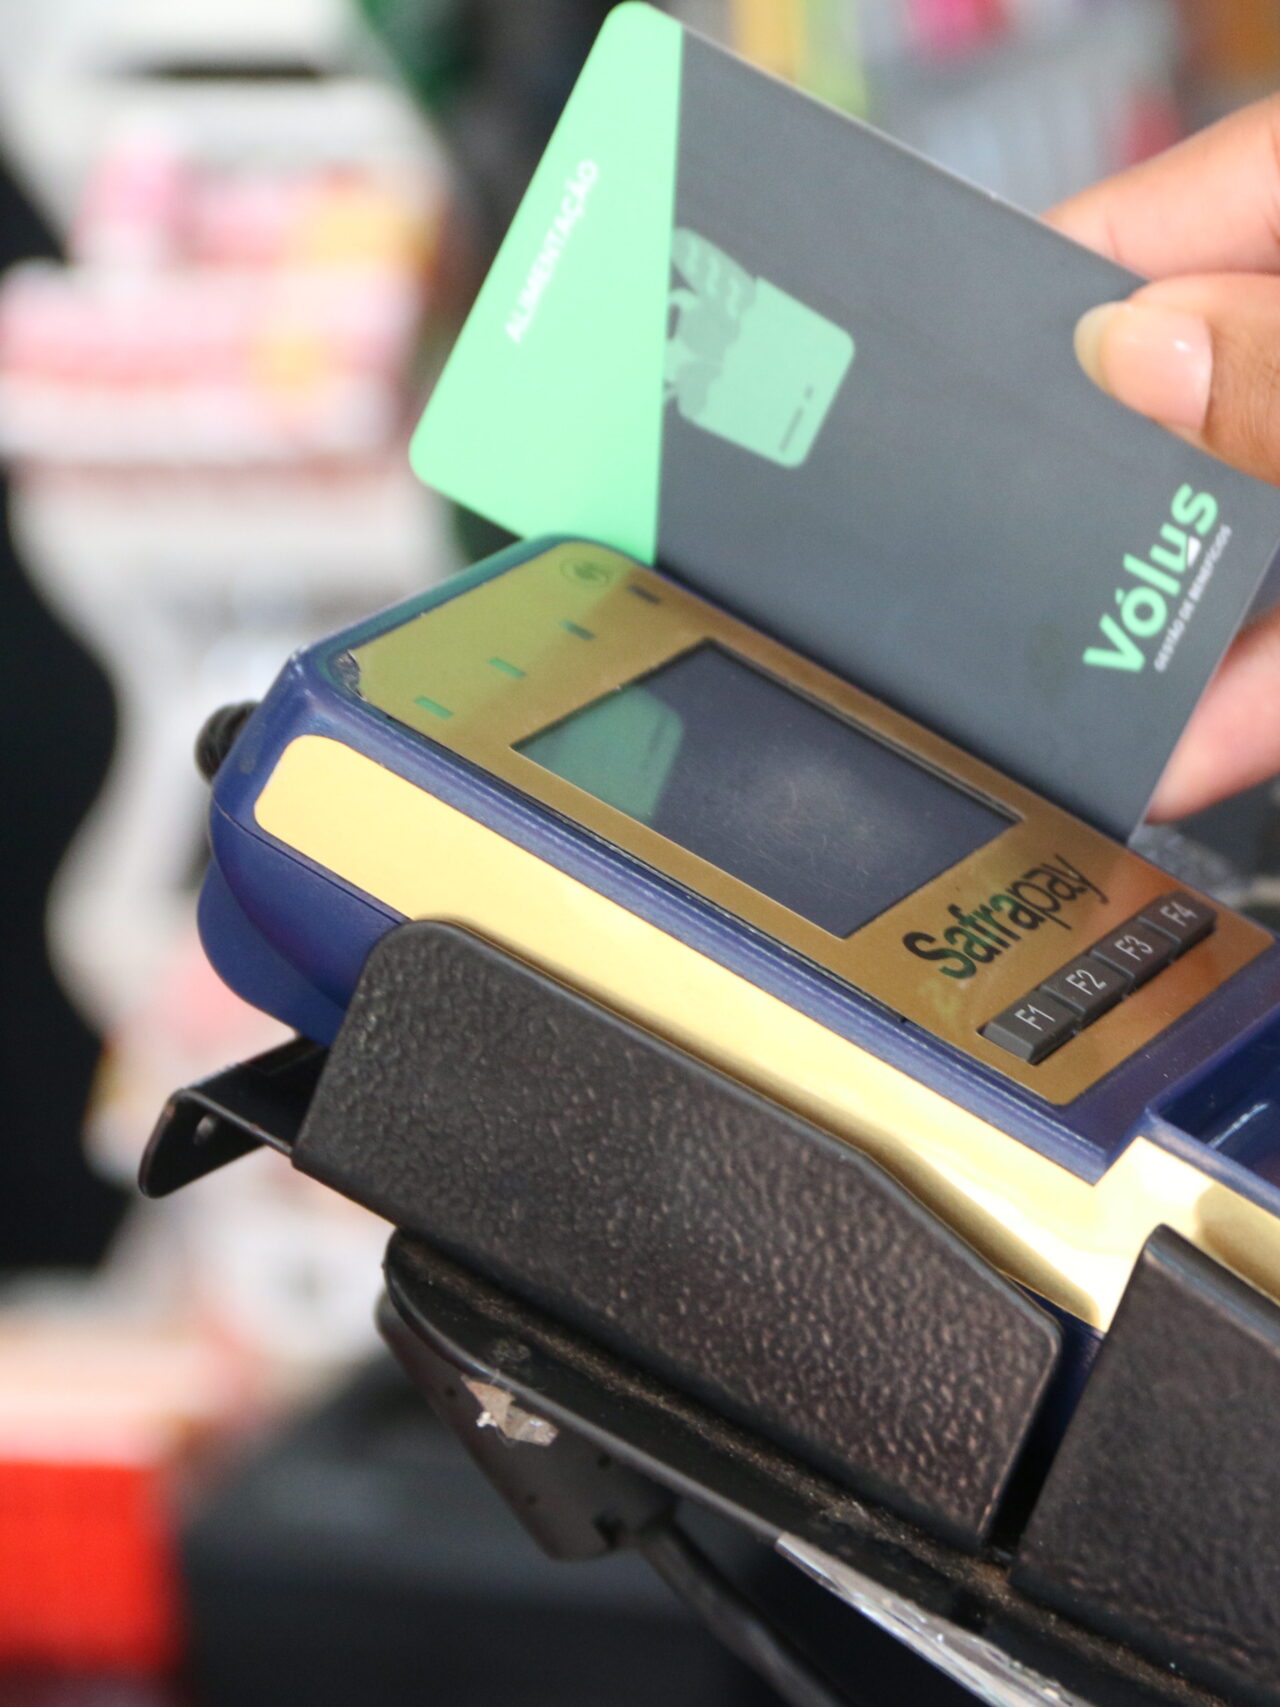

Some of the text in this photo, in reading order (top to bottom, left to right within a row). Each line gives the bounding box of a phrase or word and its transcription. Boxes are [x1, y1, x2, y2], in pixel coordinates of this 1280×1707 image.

[504, 159, 599, 344] ALIMENTAÇÃO
[1082, 483, 1218, 672] Vólus
[902, 854, 1109, 980] Safrapay
[1014, 901, 1199, 1032] F1 F2 F3 F4
